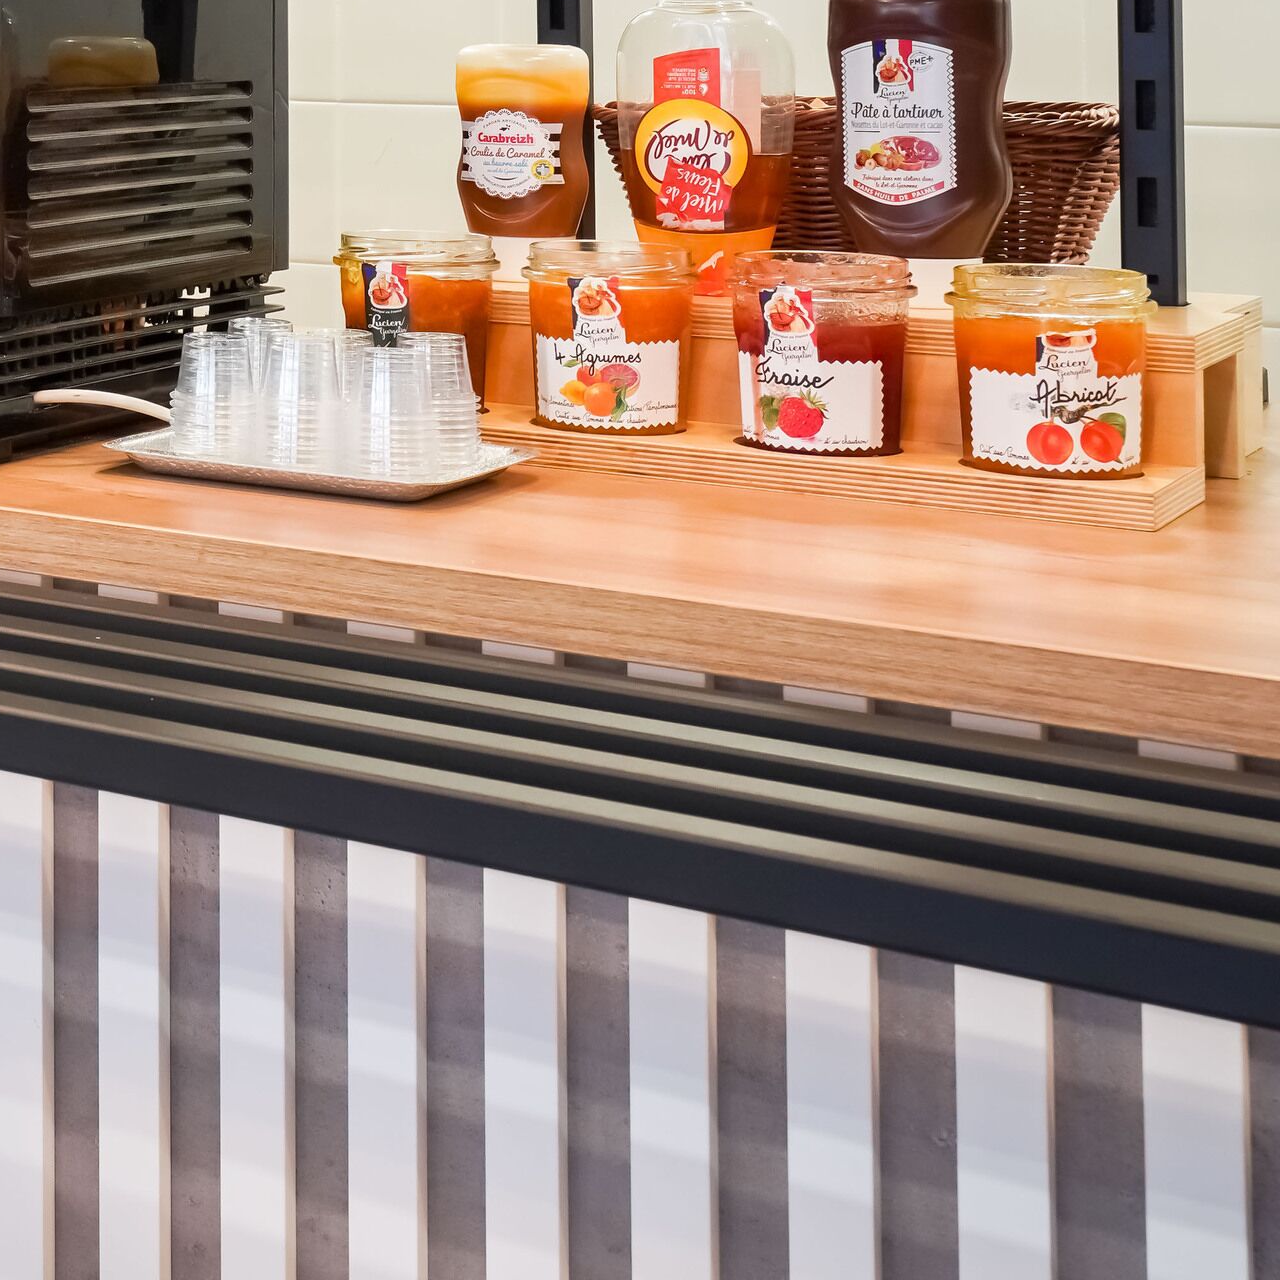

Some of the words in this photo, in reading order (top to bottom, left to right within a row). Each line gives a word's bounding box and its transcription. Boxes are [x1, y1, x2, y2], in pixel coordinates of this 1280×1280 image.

[879, 87, 907, 99] Lucien
[851, 102, 880, 119] Pâte
[882, 103, 890, 119] à
[892, 103, 945, 119] tartiner
[478, 132, 534, 144] Carabreizh
[653, 120, 711, 160] Miel
[471, 146, 494, 158] Coulis
[495, 148, 506, 158] de
[506, 147, 545, 159] Caramel
[677, 168, 721, 197] Fleurs
[665, 185, 680, 202] de
[857, 183, 875, 196] SANS
[874, 191, 896, 202] HUILE
[898, 193, 909, 201] DE
[911, 185, 936, 198] PALME
[679, 191, 724, 214] Miel
[368, 313, 406, 330] Lucien
[575, 322, 617, 339] Lucien
[766, 338, 810, 354] Lucien
[554, 342, 566, 365] 4
[570, 343, 642, 376] Agrumes
[1038, 354, 1091, 371] Lucien
[755, 356, 835, 389] Fraise
[1029, 379, 1127, 419] Abricot
